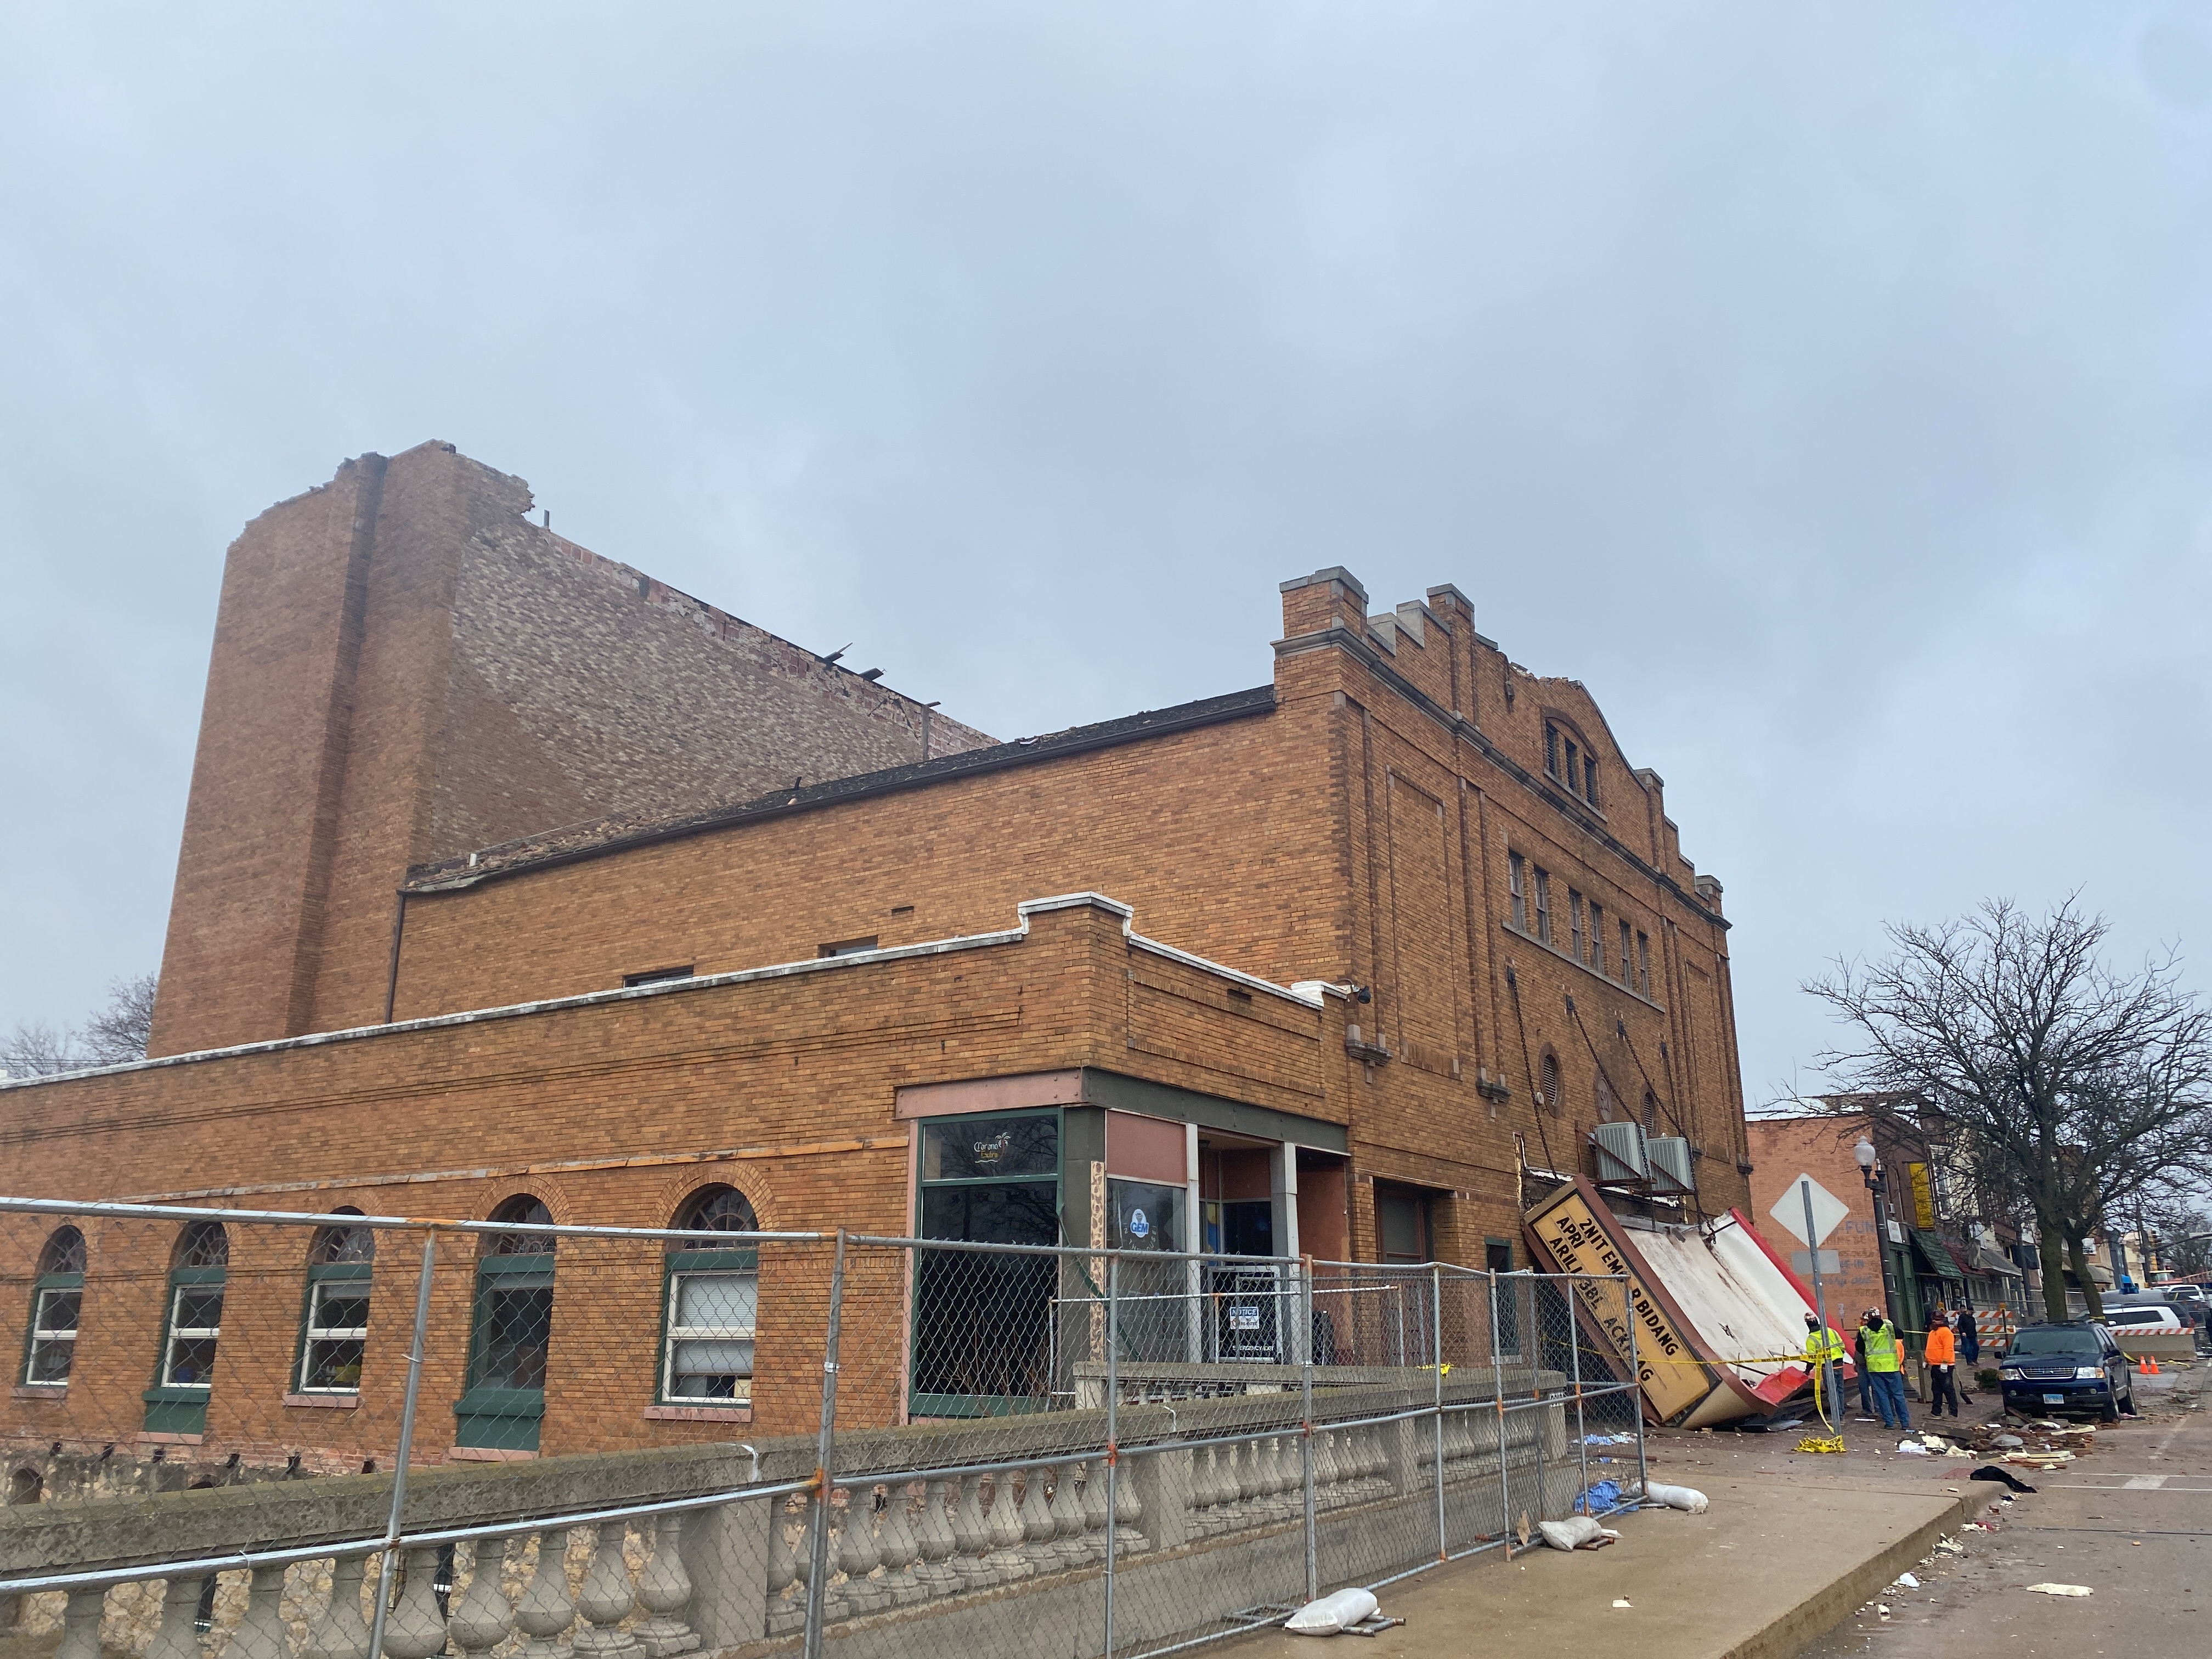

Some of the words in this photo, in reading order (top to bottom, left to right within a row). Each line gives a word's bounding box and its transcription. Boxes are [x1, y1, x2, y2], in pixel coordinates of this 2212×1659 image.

[974, 1142, 998, 1152] Corona
[1131, 1222, 1148, 1233] GEM
[1556, 1216, 1586, 1249] APRI
